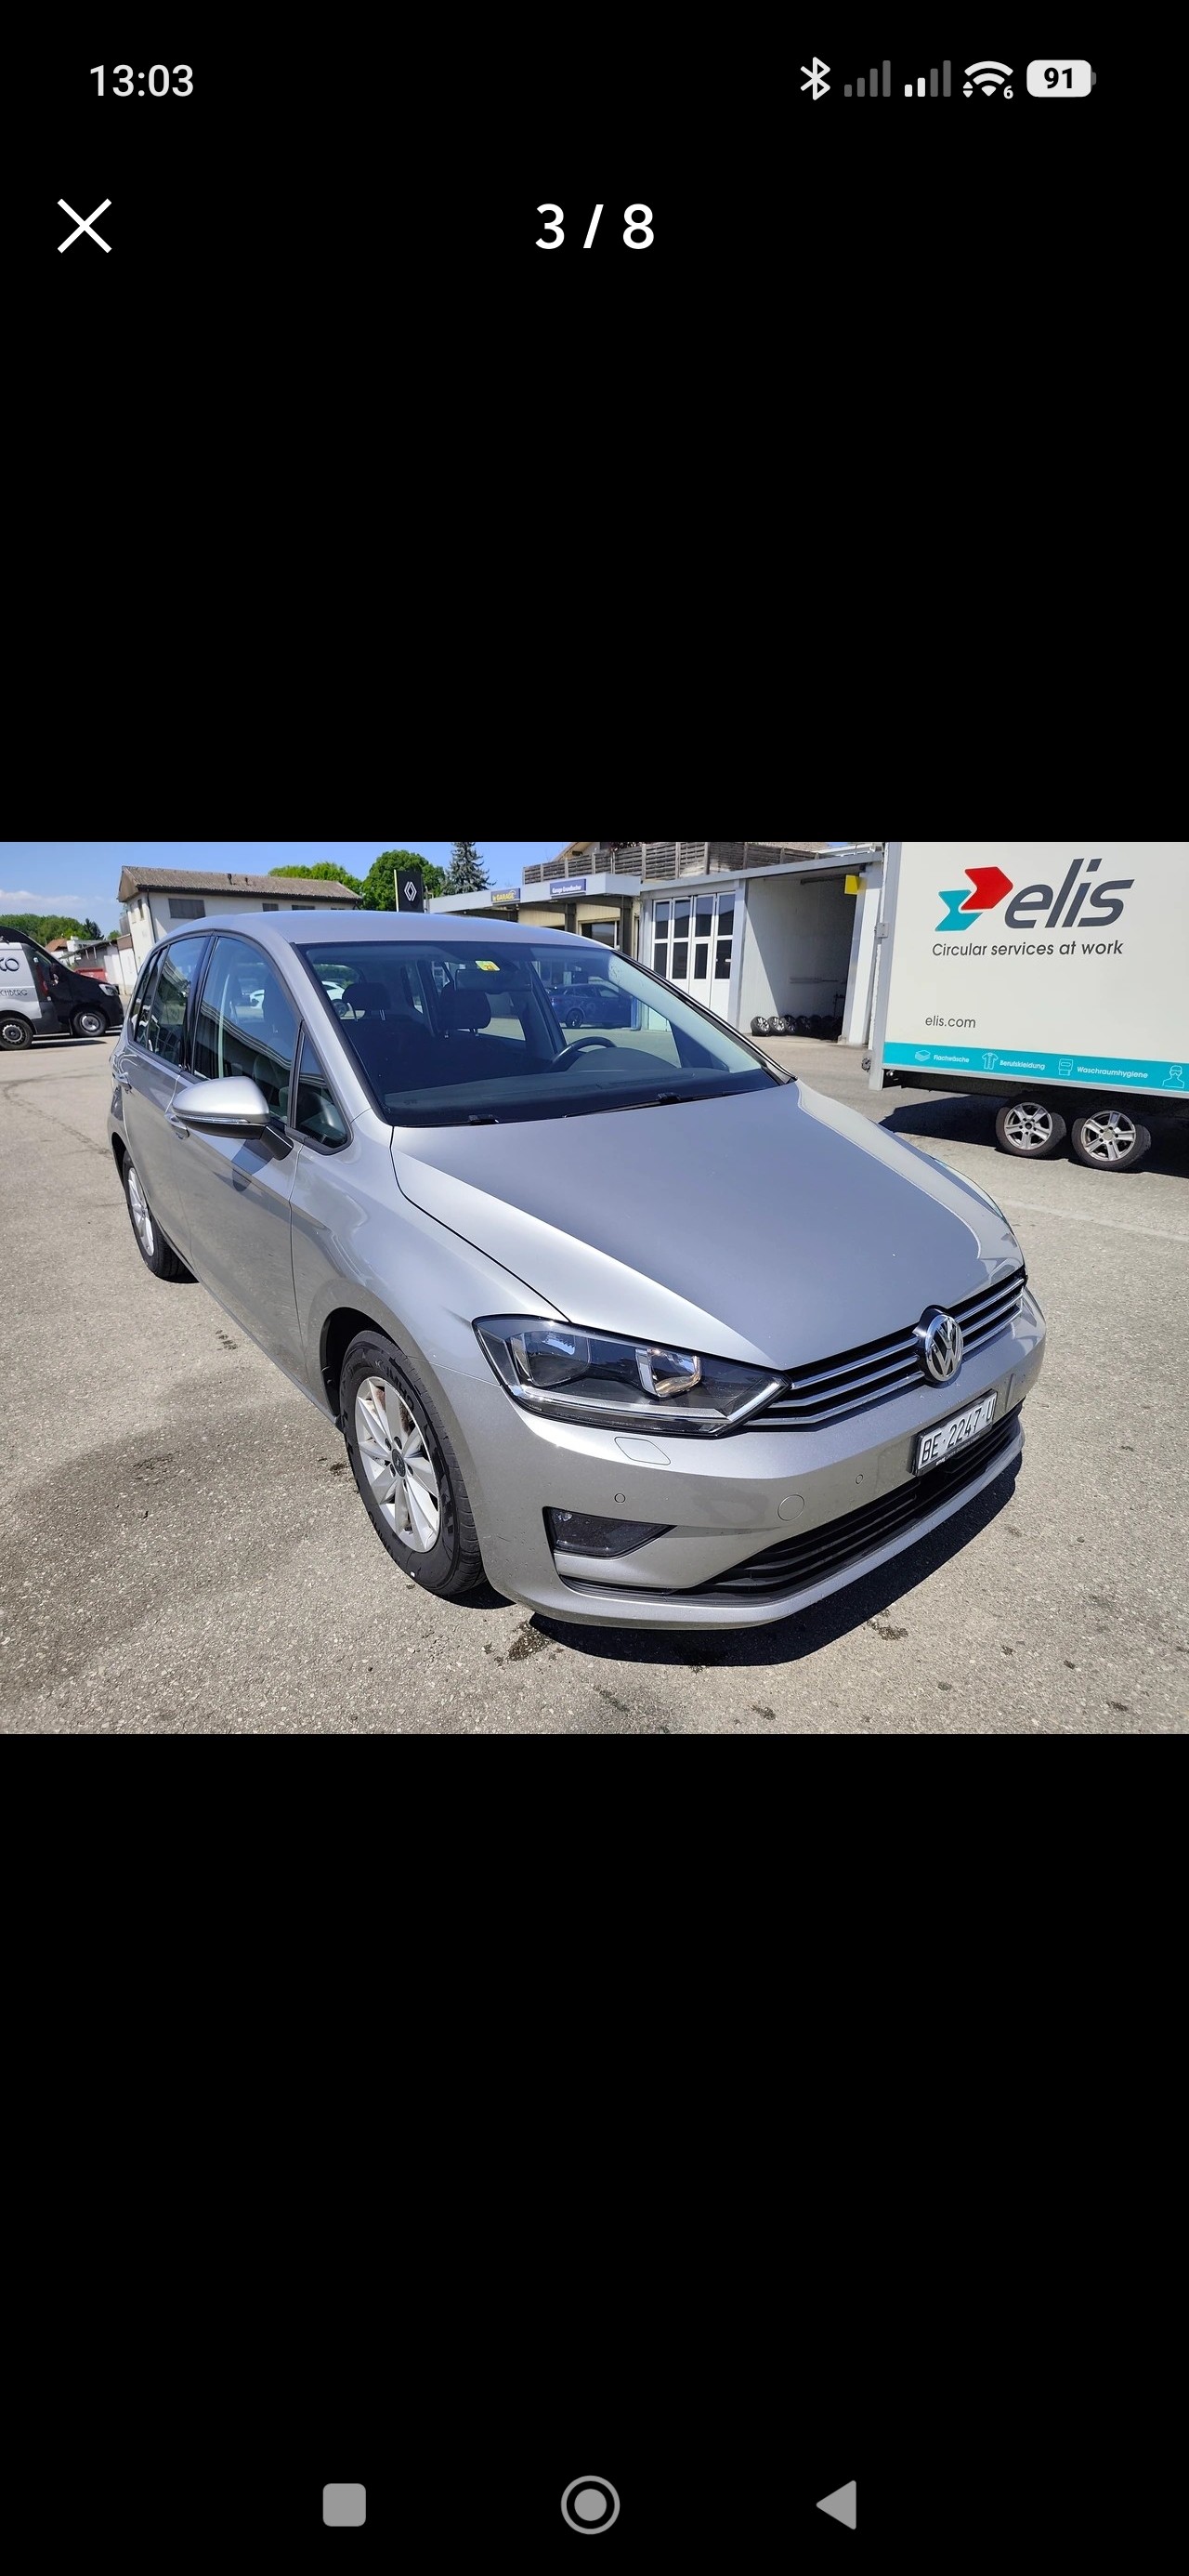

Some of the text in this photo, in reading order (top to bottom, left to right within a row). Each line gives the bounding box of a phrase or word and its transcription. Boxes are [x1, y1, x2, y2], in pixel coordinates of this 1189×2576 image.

[1004, 858, 1135, 929] elis
[932, 940, 1124, 957] Circular services at work
[924, 1015, 976, 1029] elis.com
[1000, 1059, 1046, 1071] Berufskleidung
[1077, 1066, 1149, 1079] Waschraumhygiene
